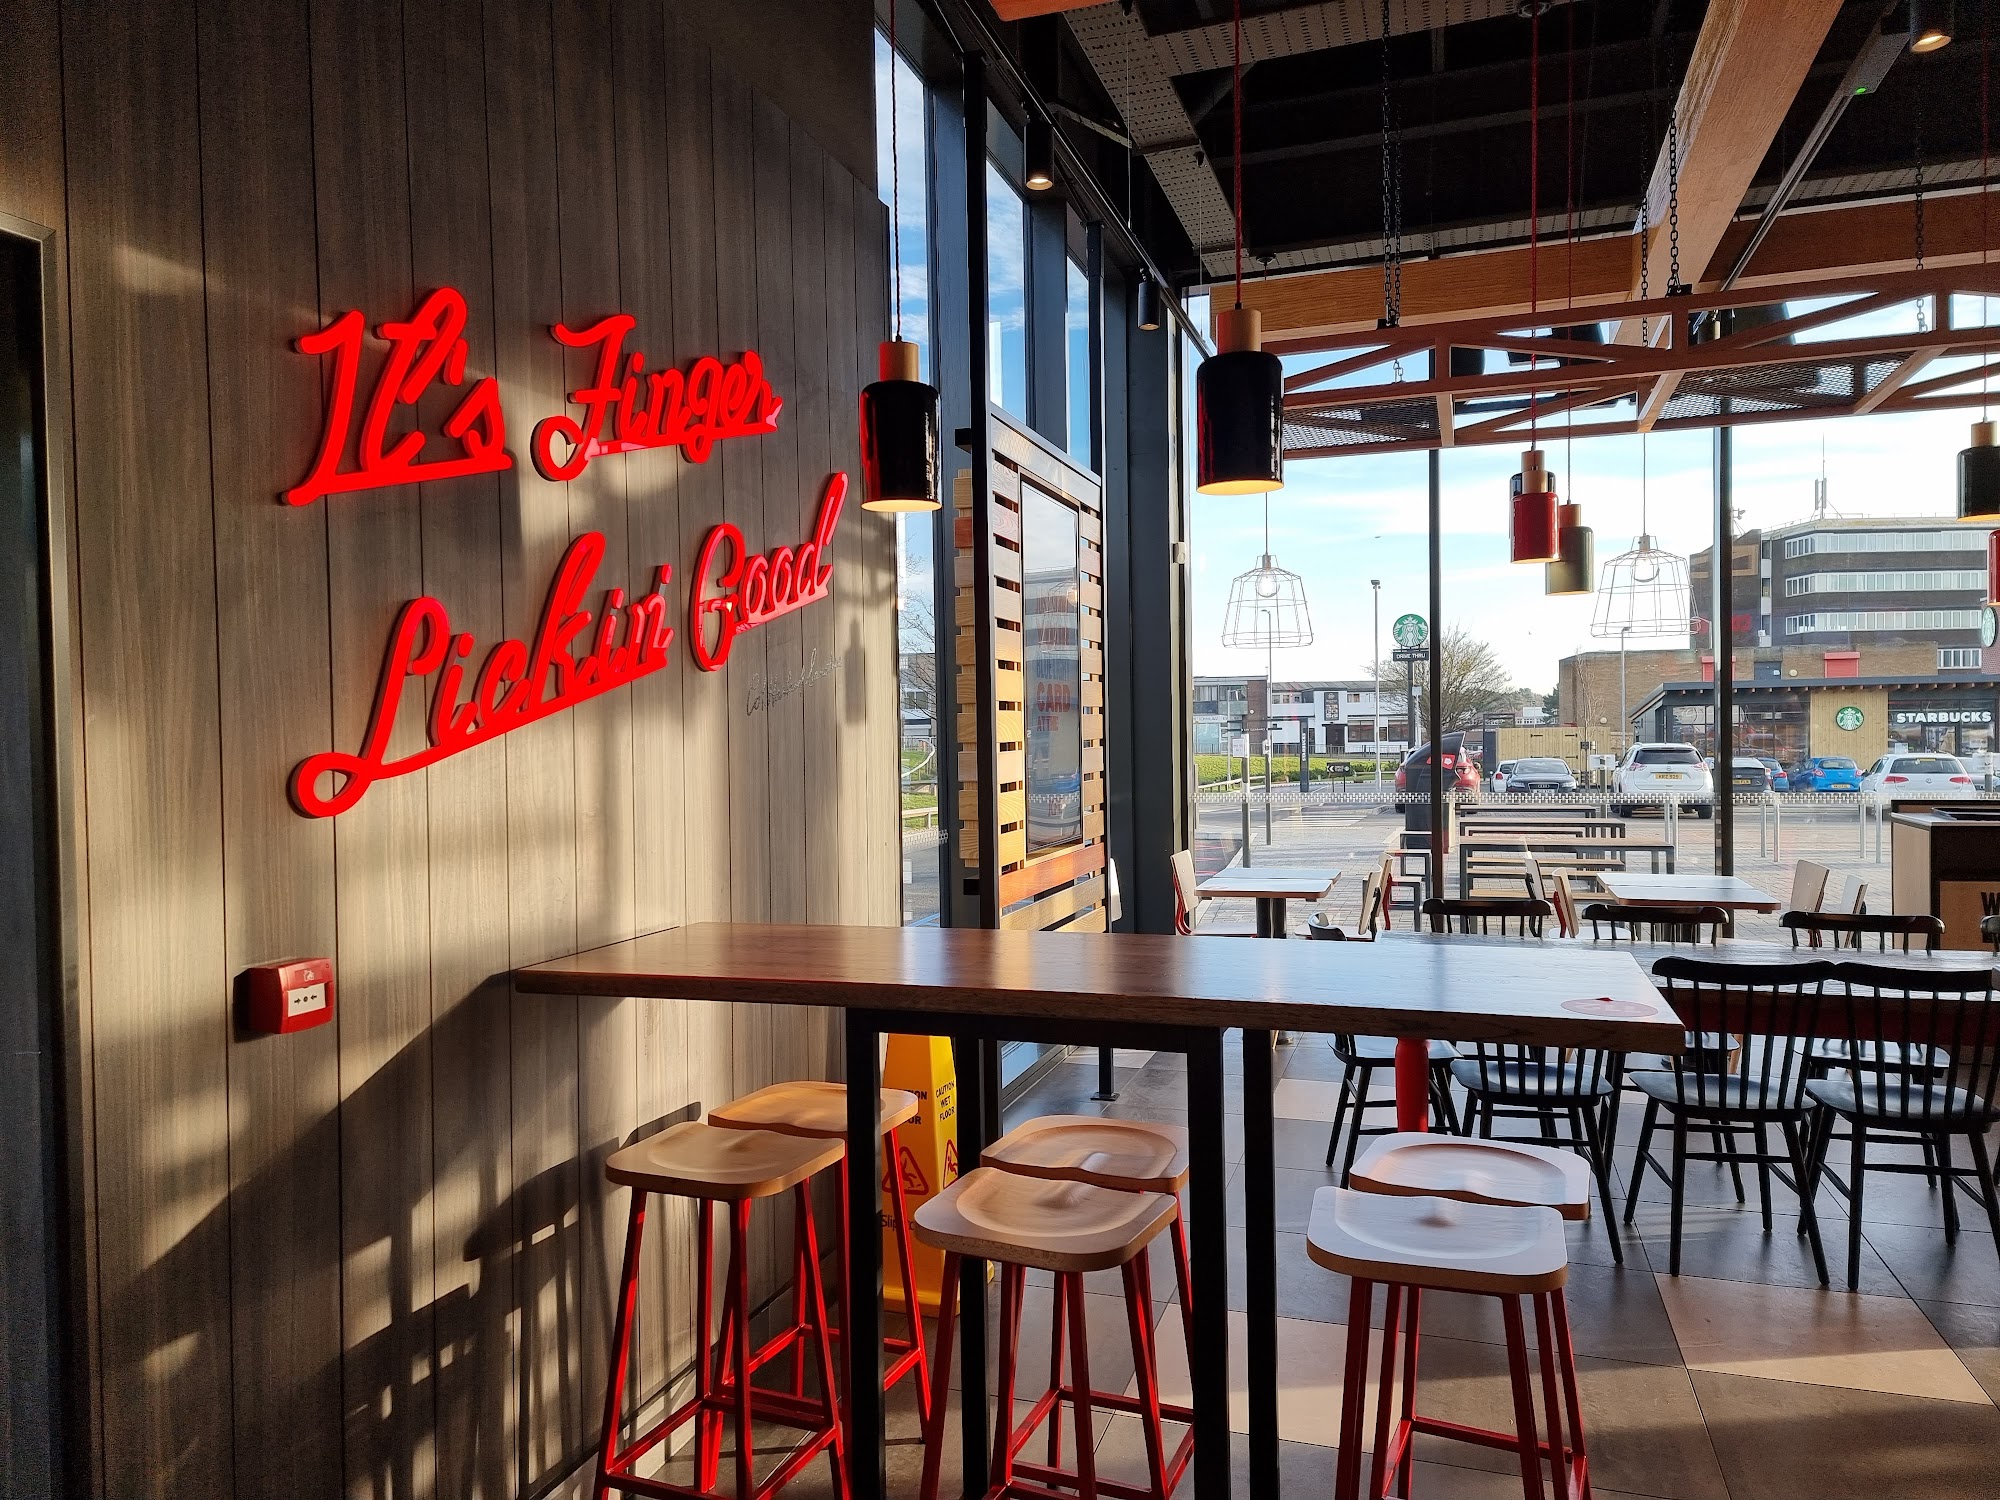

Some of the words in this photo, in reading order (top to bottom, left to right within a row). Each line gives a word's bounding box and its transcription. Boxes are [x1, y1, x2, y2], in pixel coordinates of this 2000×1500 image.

[283, 286, 513, 508] It's
[532, 313, 784, 482] Finger
[690, 471, 848, 673] Good
[1036, 681, 1071, 713] CARD
[1896, 711, 1992, 723] STARBUCKS
[936, 1080, 955, 1098] CAUTION
[940, 1095, 951, 1108] WET
[939, 1106, 955, 1122] FLOOR
